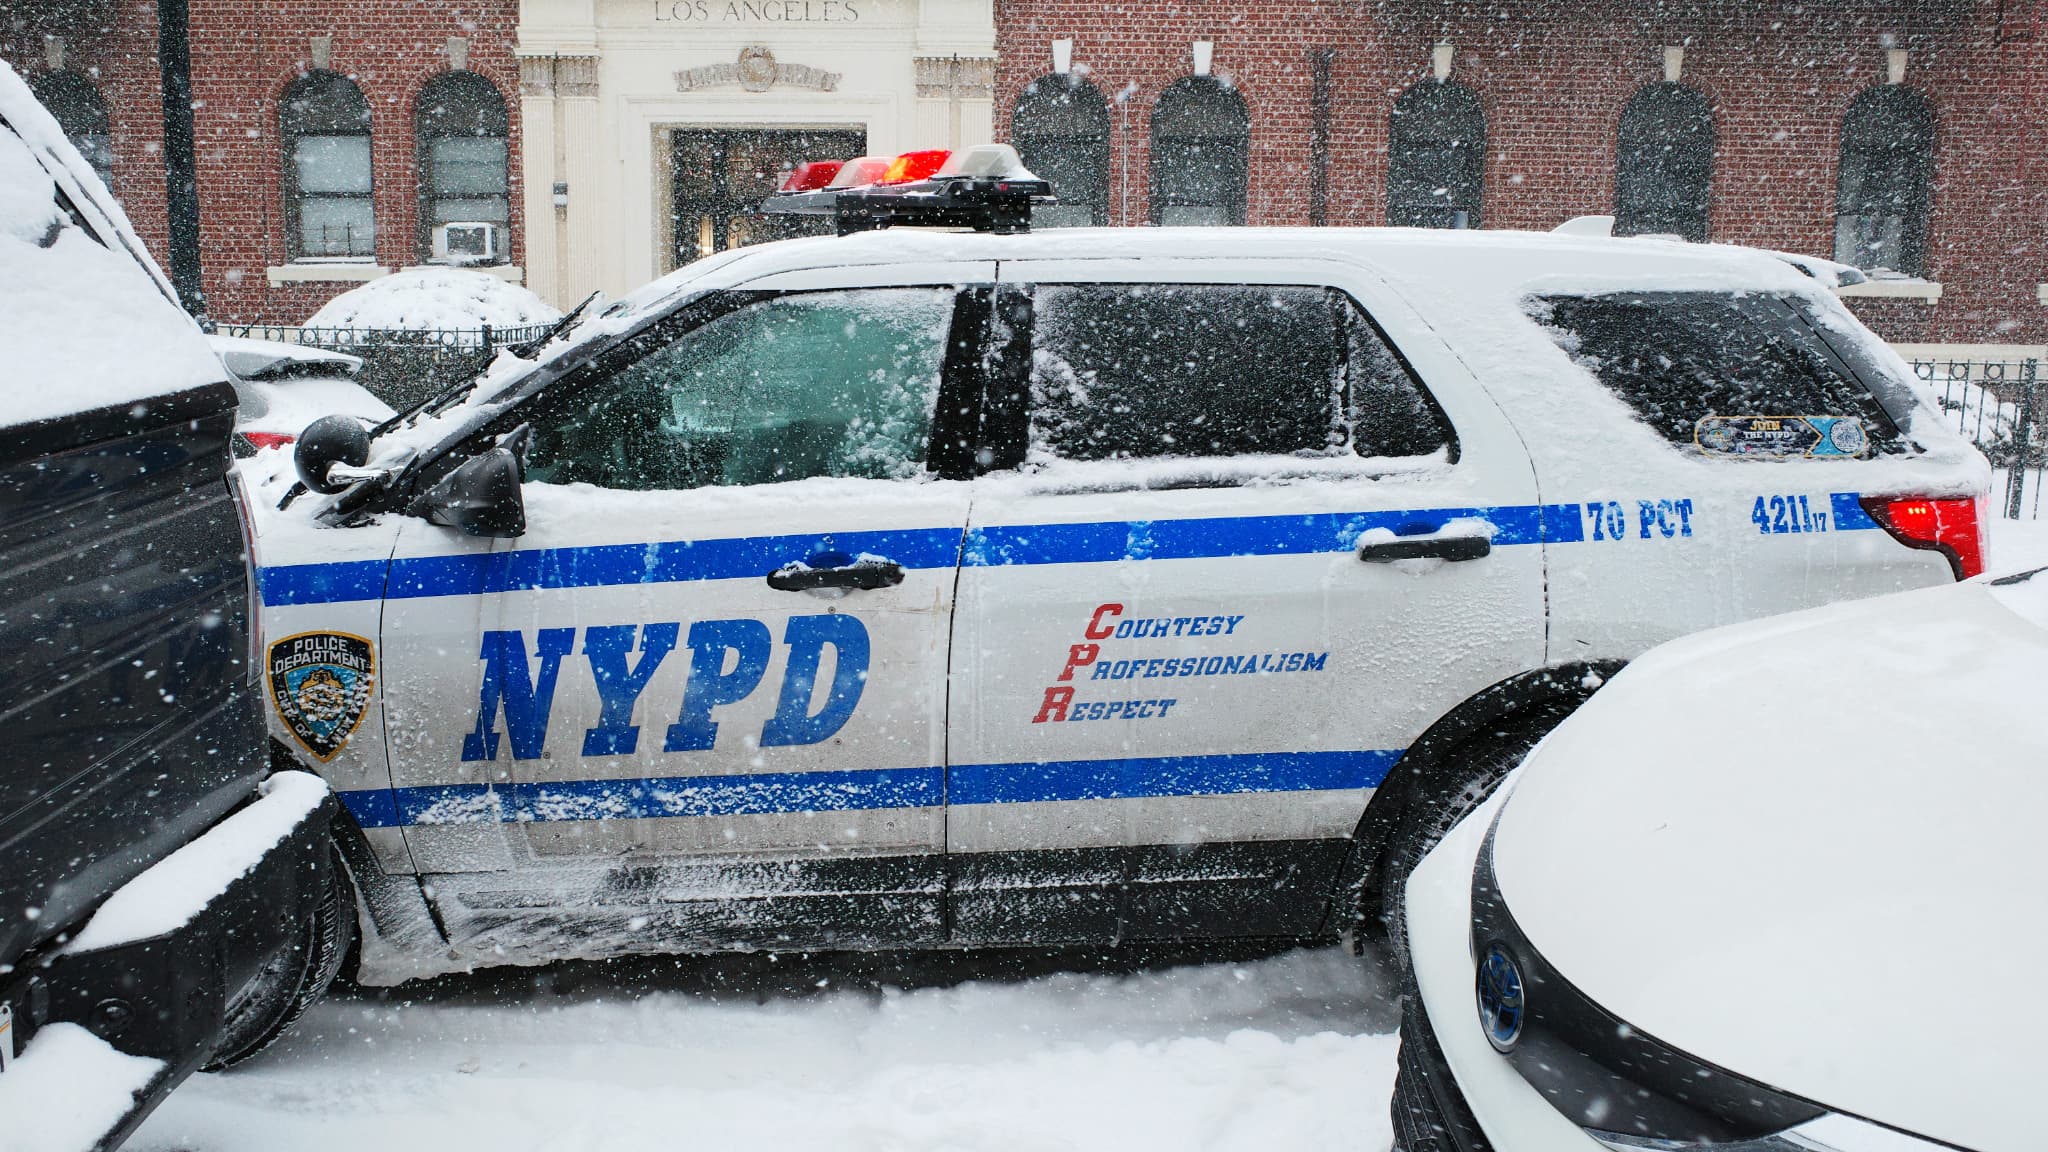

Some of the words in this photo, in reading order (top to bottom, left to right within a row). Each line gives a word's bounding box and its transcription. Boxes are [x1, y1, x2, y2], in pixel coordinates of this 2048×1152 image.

[654, 1, 708, 21] LOS
[722, 1, 858, 21] ANGELES
[1743, 431, 1762, 439] THE
[1587, 501, 1625, 541] 70
[1637, 498, 1693, 539] PCT
[1752, 495, 1812, 534] 4211
[1085, 603, 1244, 640] COURTESY
[275, 650, 366, 675] DEPARTMENT
[294, 637, 348, 653] POLICE
[1057, 643, 1329, 682] PROFESSIONALISM
[461, 614, 870, 762] NYPD
[1032, 686, 1176, 724] RESPECT
[295, 723, 312, 738] OF
